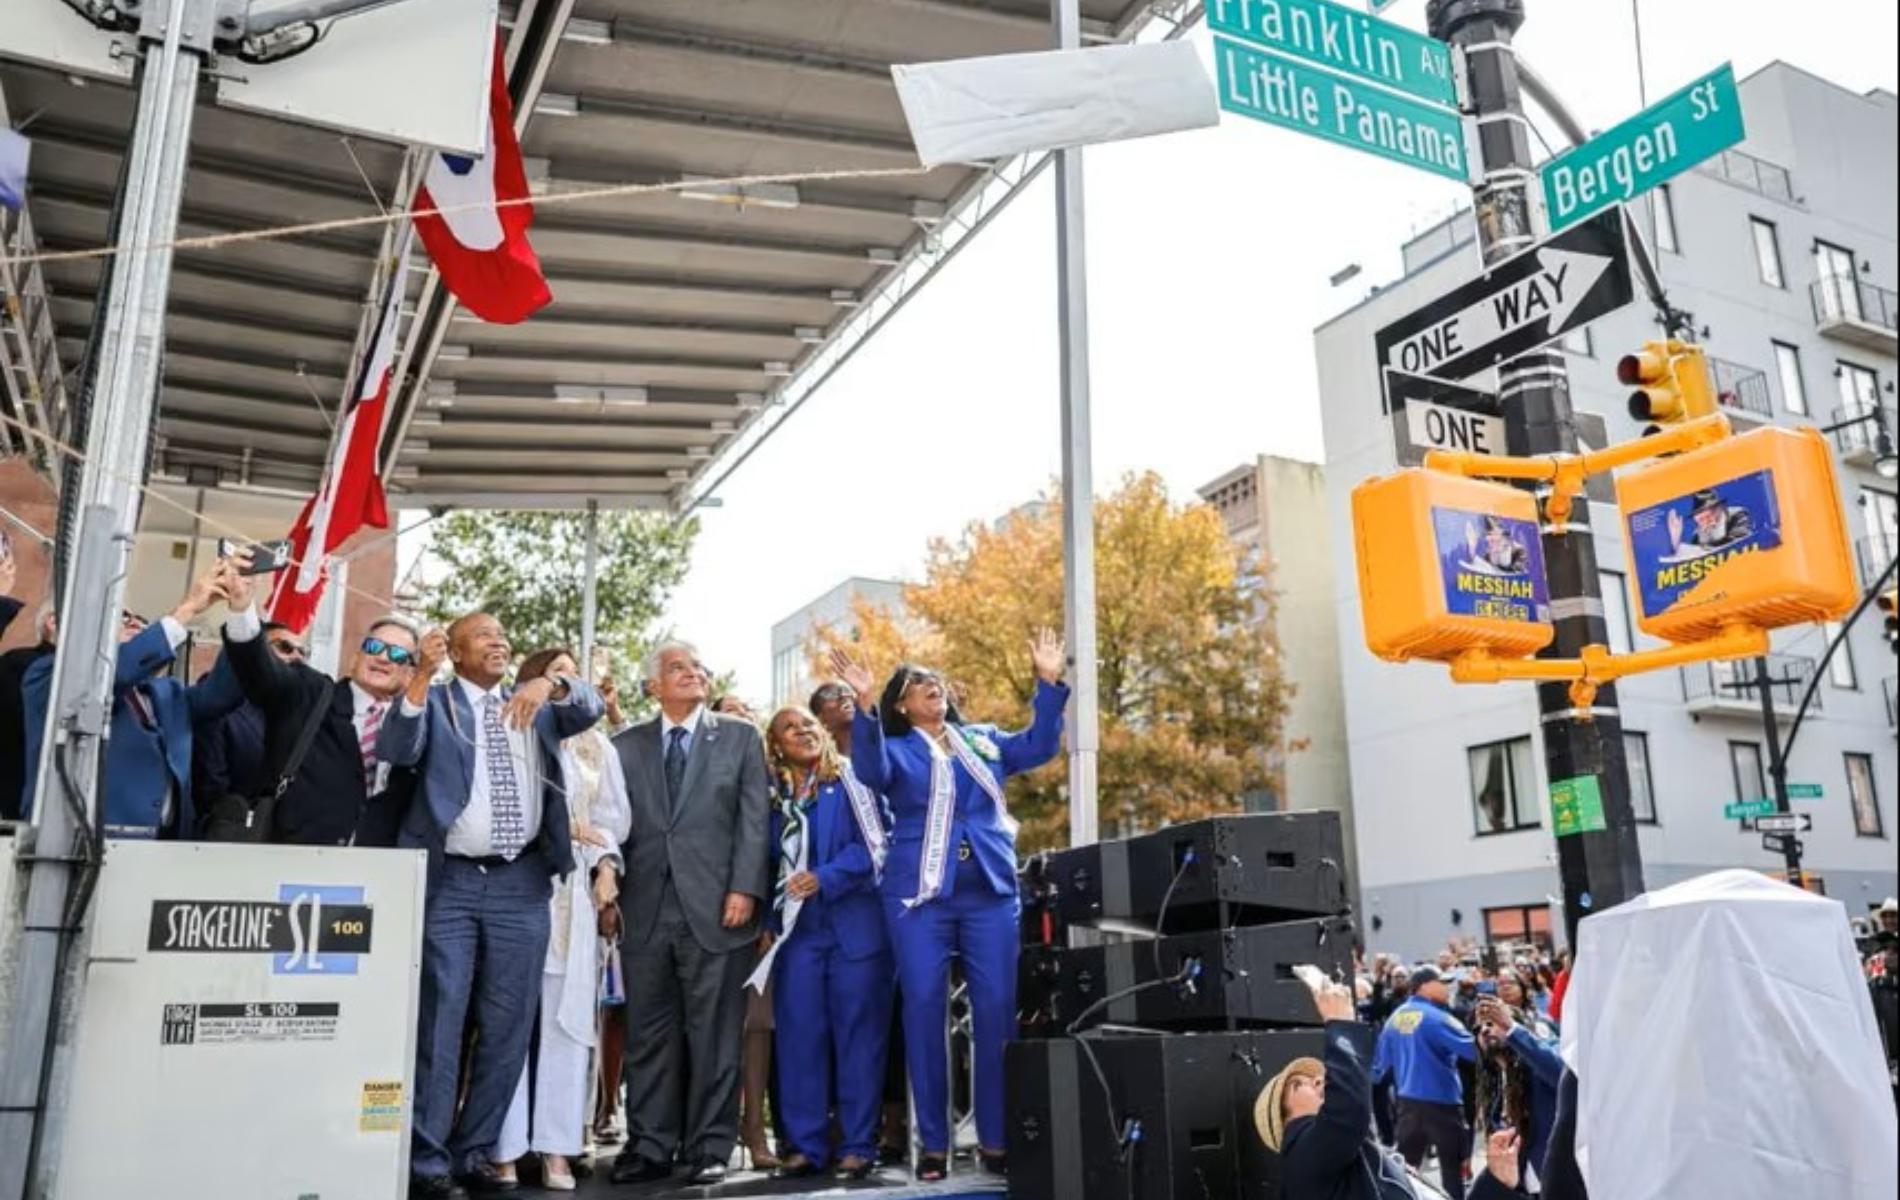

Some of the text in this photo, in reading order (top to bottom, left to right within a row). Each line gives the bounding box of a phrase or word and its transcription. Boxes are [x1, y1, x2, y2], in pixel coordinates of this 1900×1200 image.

[1226, 49, 1461, 171] Little Panama
[1553, 80, 1720, 217] Bergen St
[1402, 261, 1569, 372] ONE WAY
[1426, 408, 1490, 454] ONE
[1457, 573, 1533, 599] MESSIAH
[1656, 542, 1760, 590] MESS
[284, 892, 323, 971] SL
[331, 920, 364, 935] 100
[244, 1003, 298, 1017] SL 100
